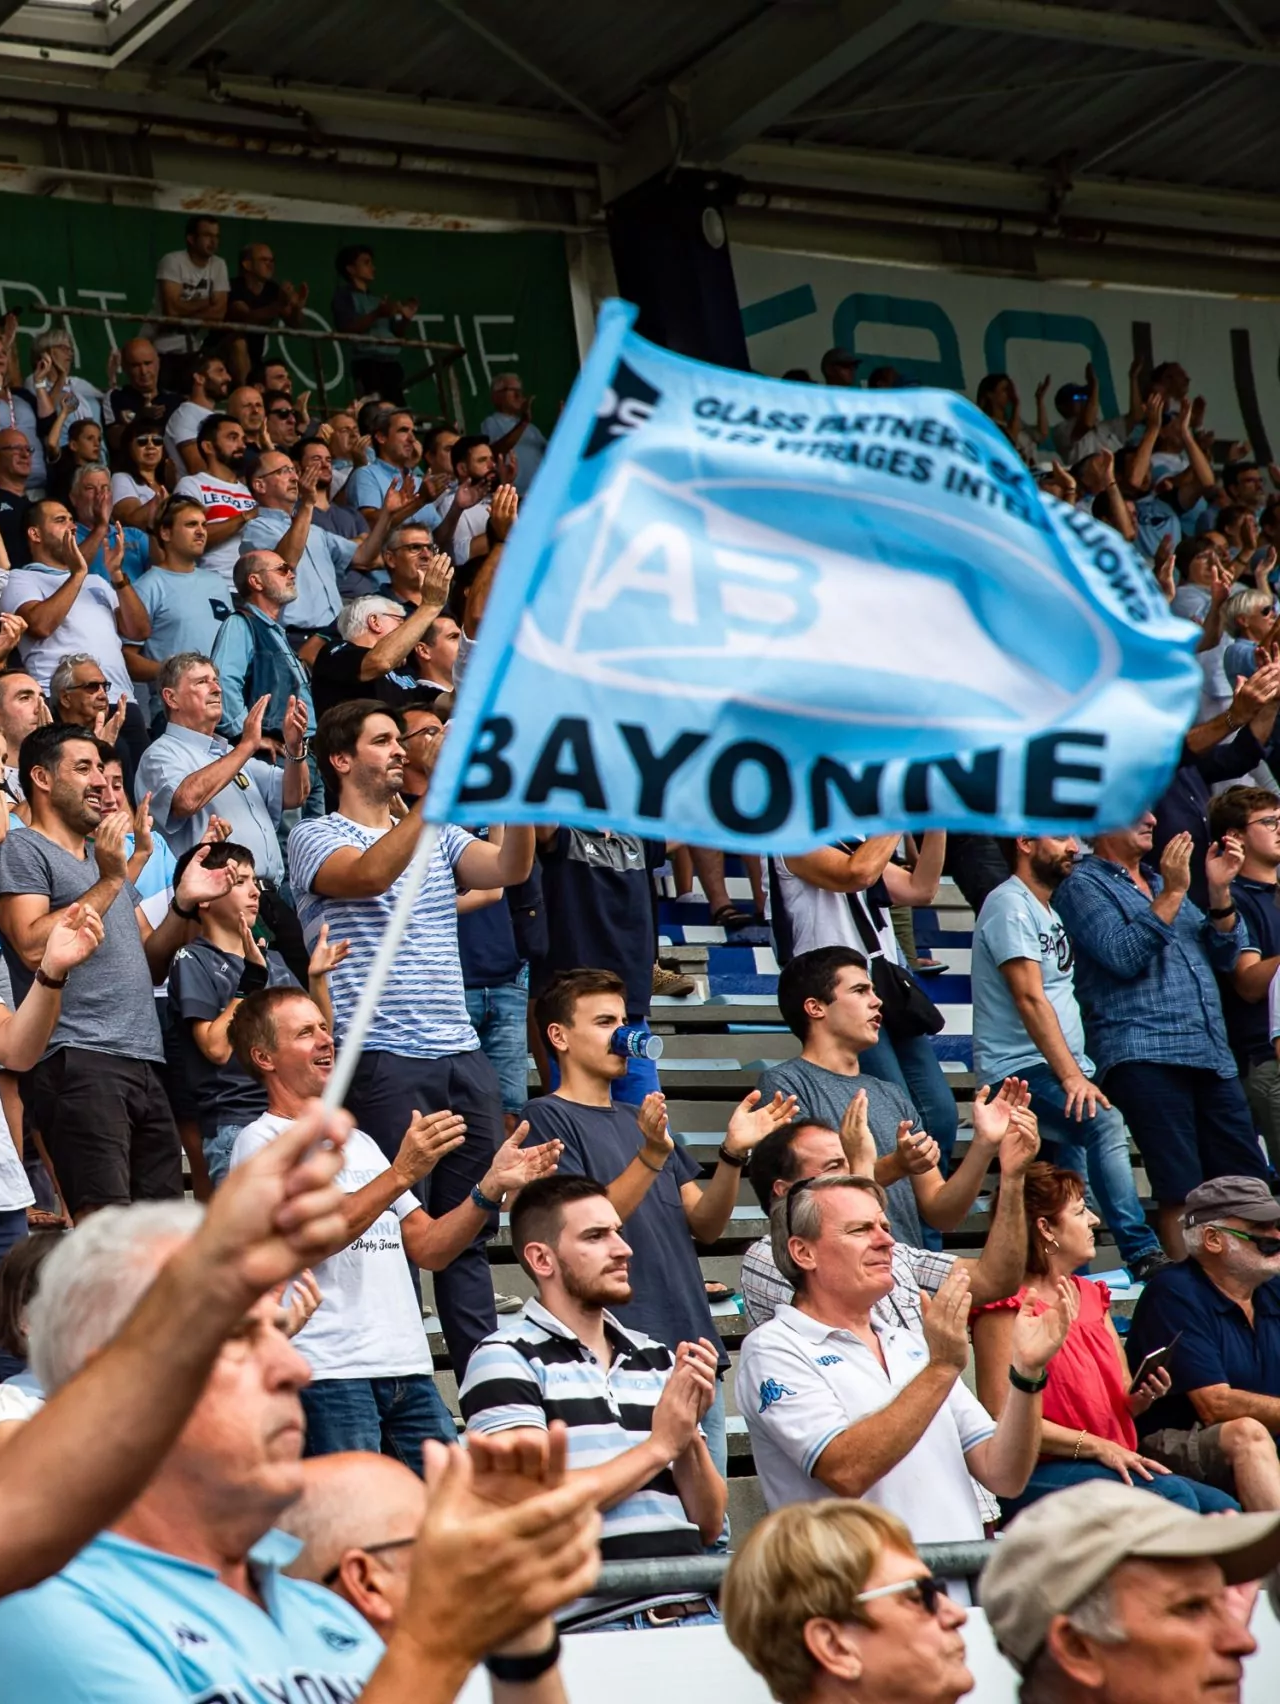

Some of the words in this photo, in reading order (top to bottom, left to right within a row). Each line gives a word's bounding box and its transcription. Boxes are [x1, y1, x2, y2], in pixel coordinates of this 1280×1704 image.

[693, 397, 809, 434] GLASS
[457, 714, 1109, 835] BAYONNE
[379, 1239, 400, 1250] Team
